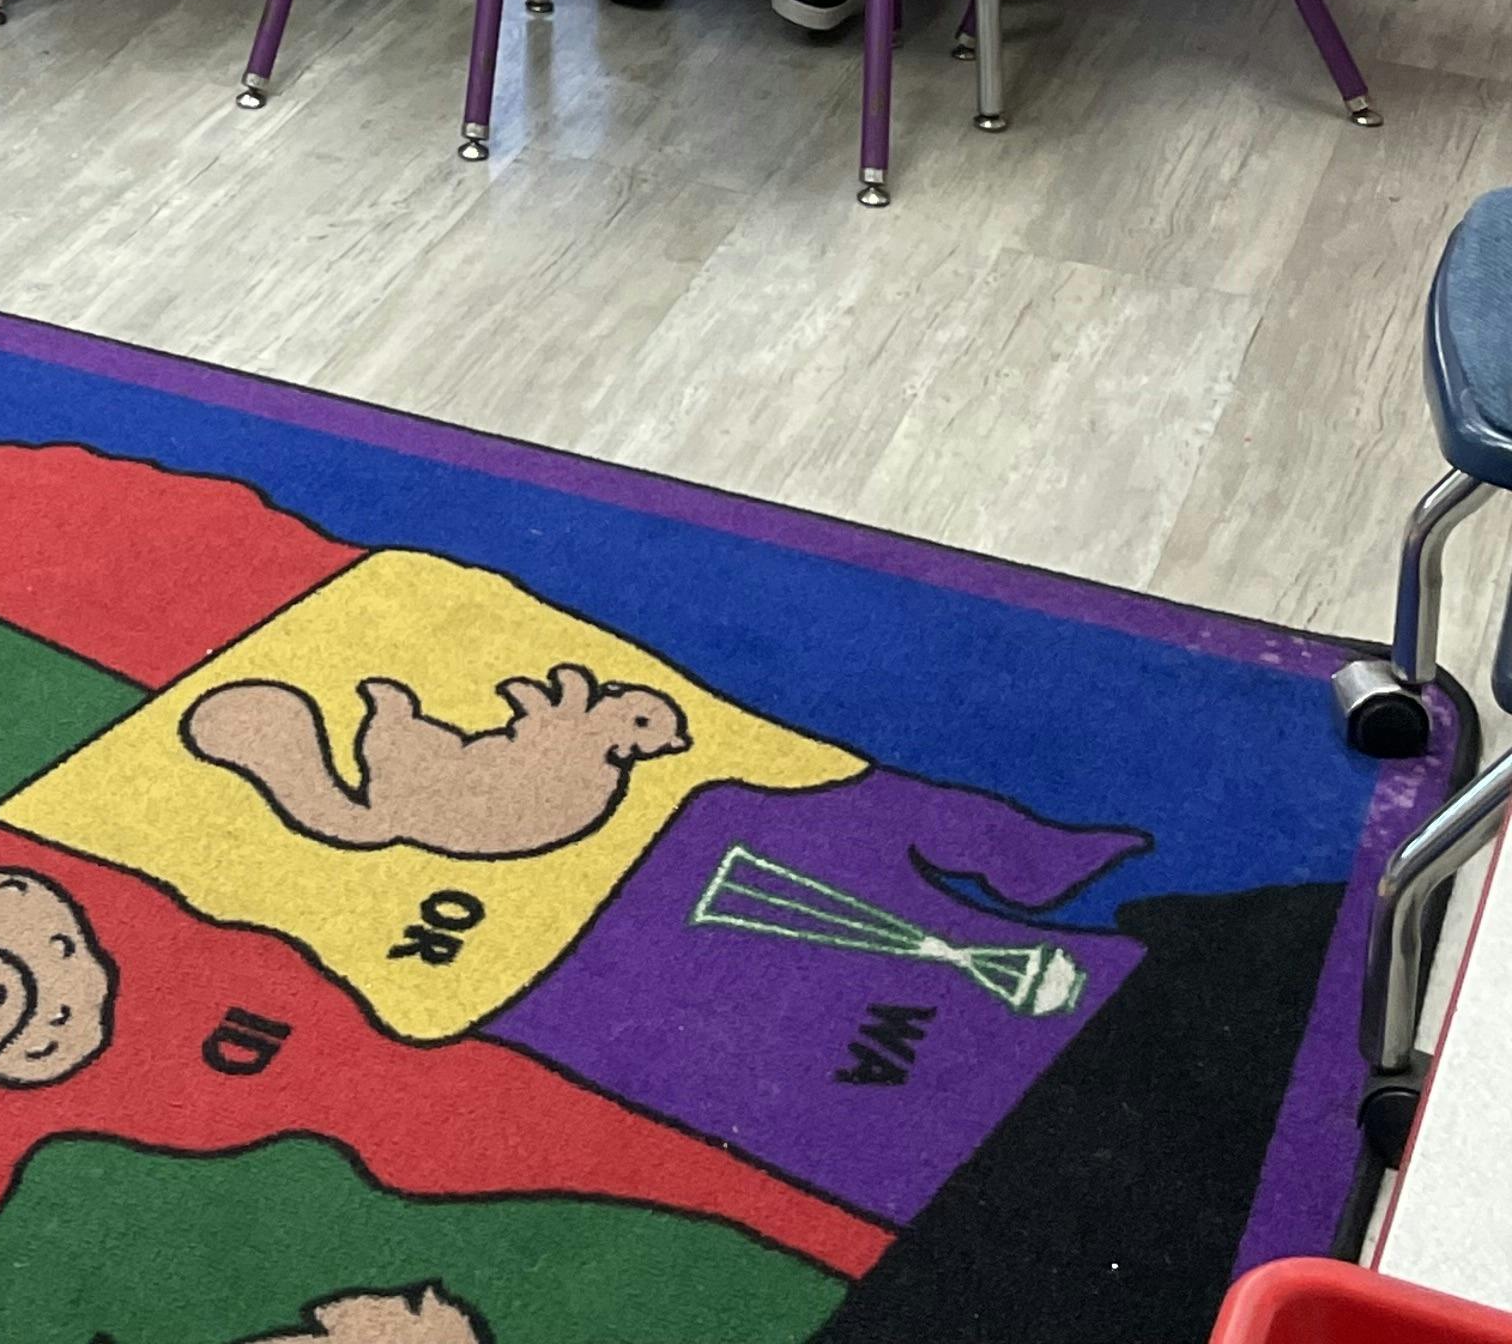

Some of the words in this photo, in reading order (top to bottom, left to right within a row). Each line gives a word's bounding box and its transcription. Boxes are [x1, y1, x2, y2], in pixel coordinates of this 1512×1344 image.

[388, 888, 486, 969] OR
[201, 1006, 292, 1077] ID
[833, 1002, 940, 1090] WA
